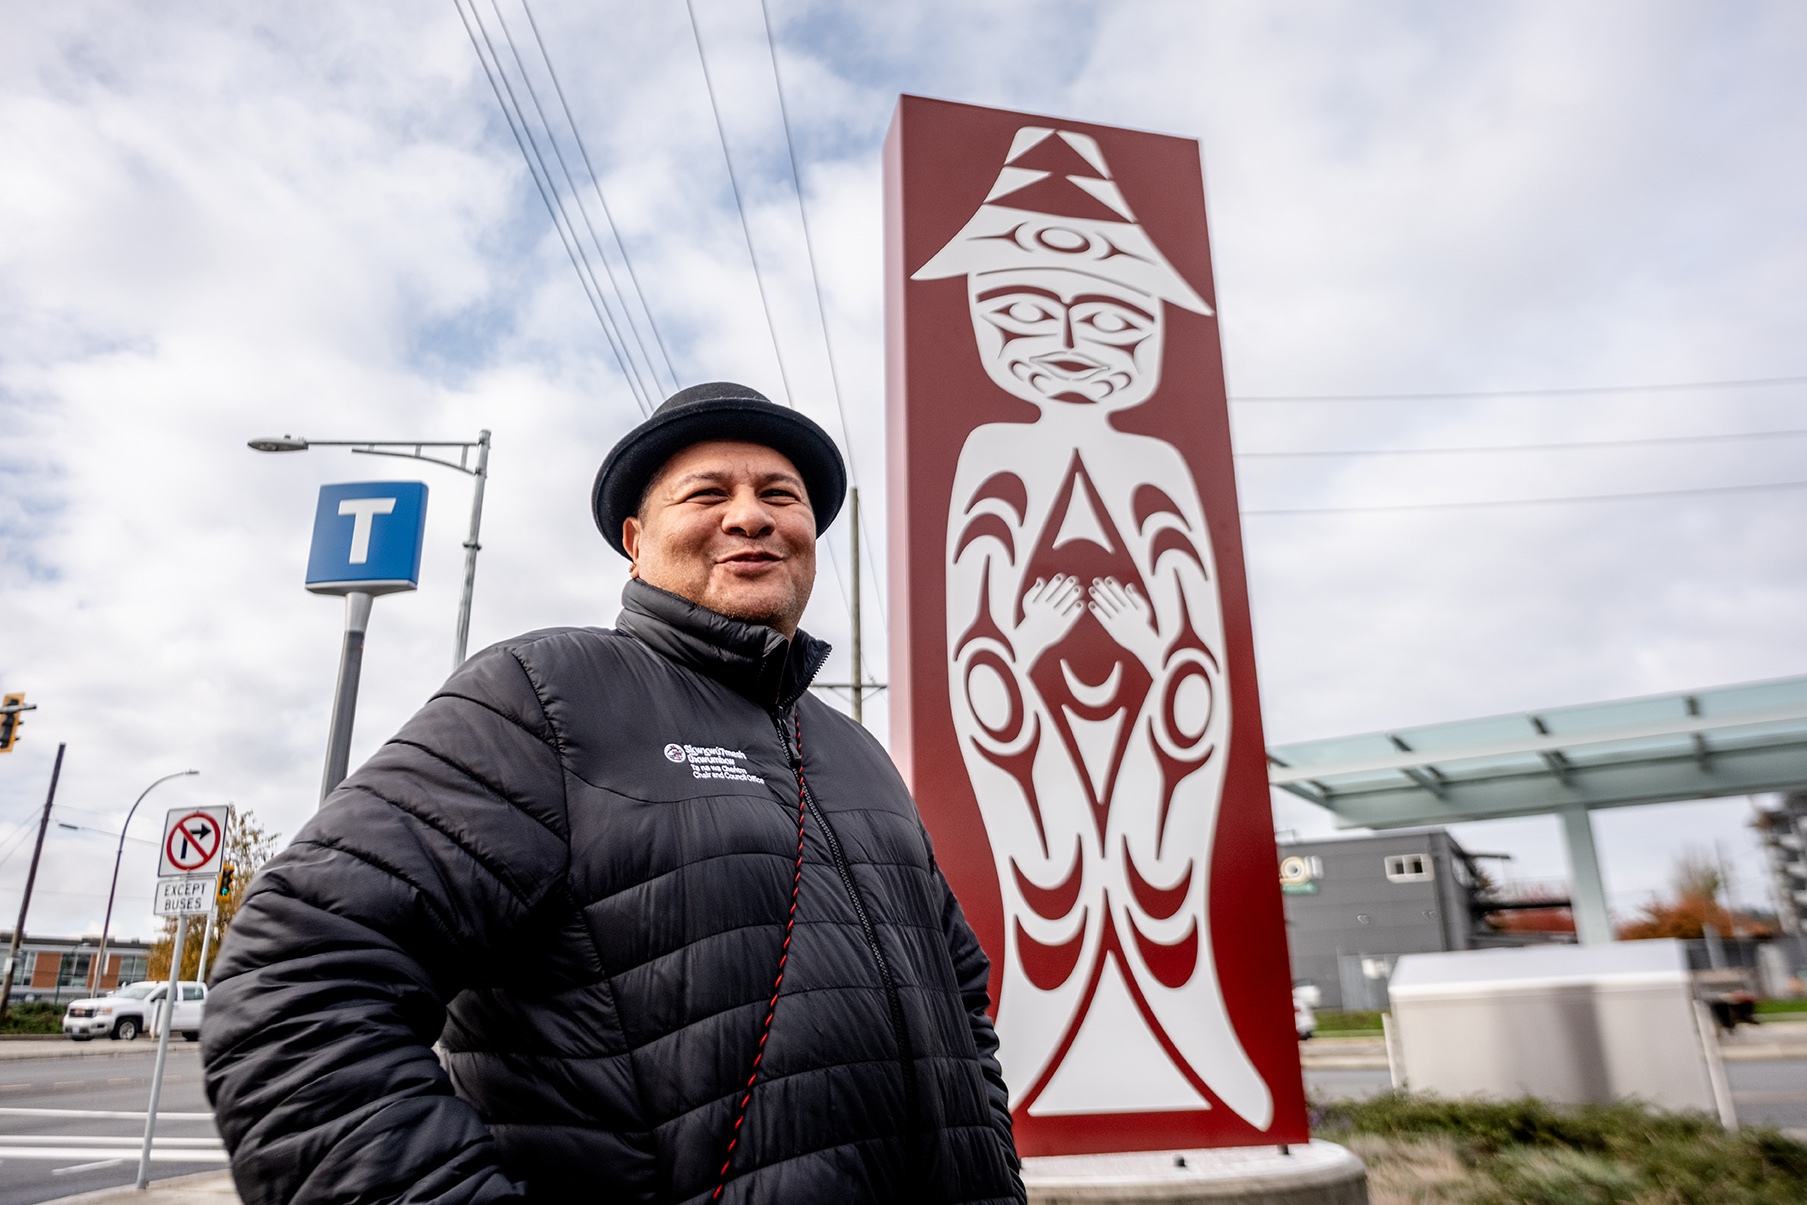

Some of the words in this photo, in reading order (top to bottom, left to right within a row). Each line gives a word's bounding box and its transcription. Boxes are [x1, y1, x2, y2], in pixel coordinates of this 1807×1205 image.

[338, 497, 397, 565] T
[692, 771, 711, 779] Chair
[712, 771, 725, 779] and
[724, 771, 748, 781] Council
[746, 774, 765, 785] Office
[164, 882, 207, 896] EXCEPT
[164, 897, 202, 911] BUSES
